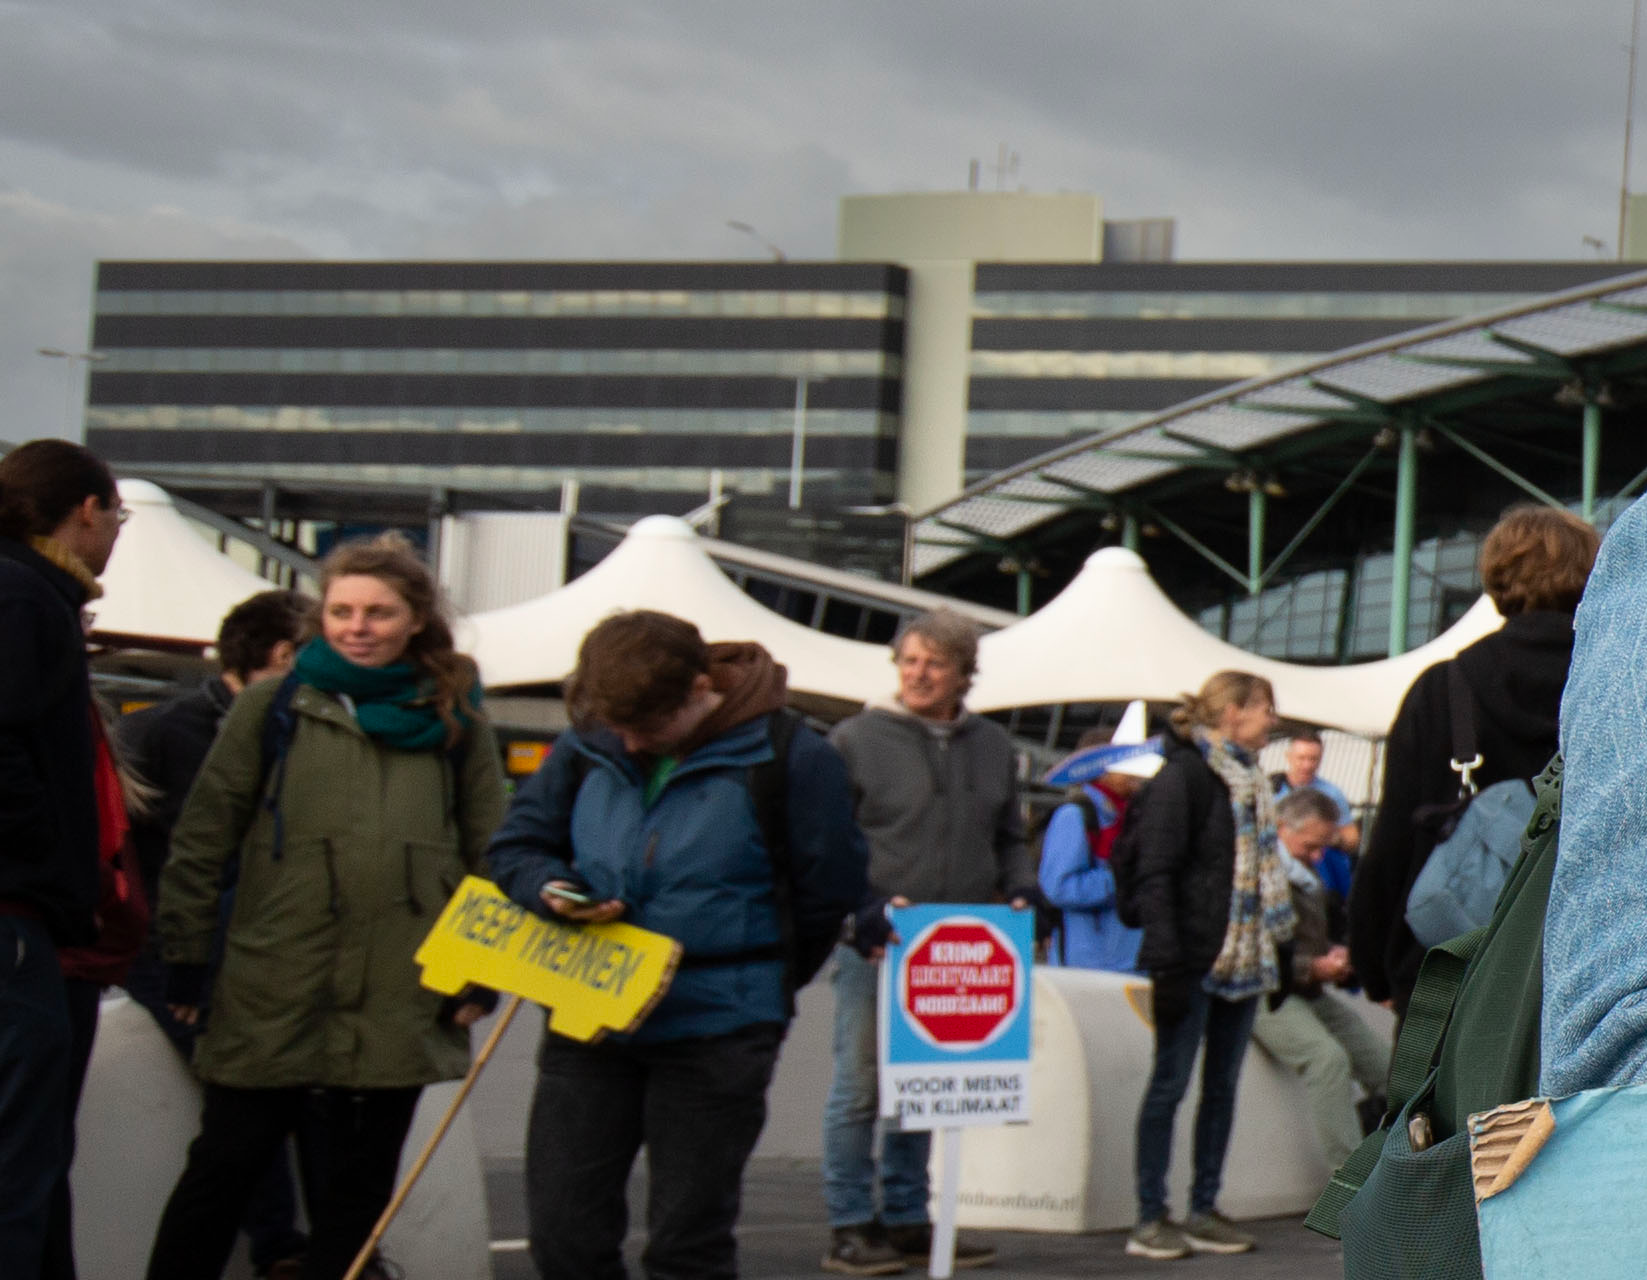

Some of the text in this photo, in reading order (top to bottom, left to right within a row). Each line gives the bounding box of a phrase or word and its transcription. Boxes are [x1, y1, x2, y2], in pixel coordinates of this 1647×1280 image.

[446, 891, 646, 998] MEER TREINEN
[930, 940, 995, 963] KRIMP
[895, 1074, 1022, 1095] VOOR MENS
[894, 1095, 1021, 1116] EN KLIMAAT
